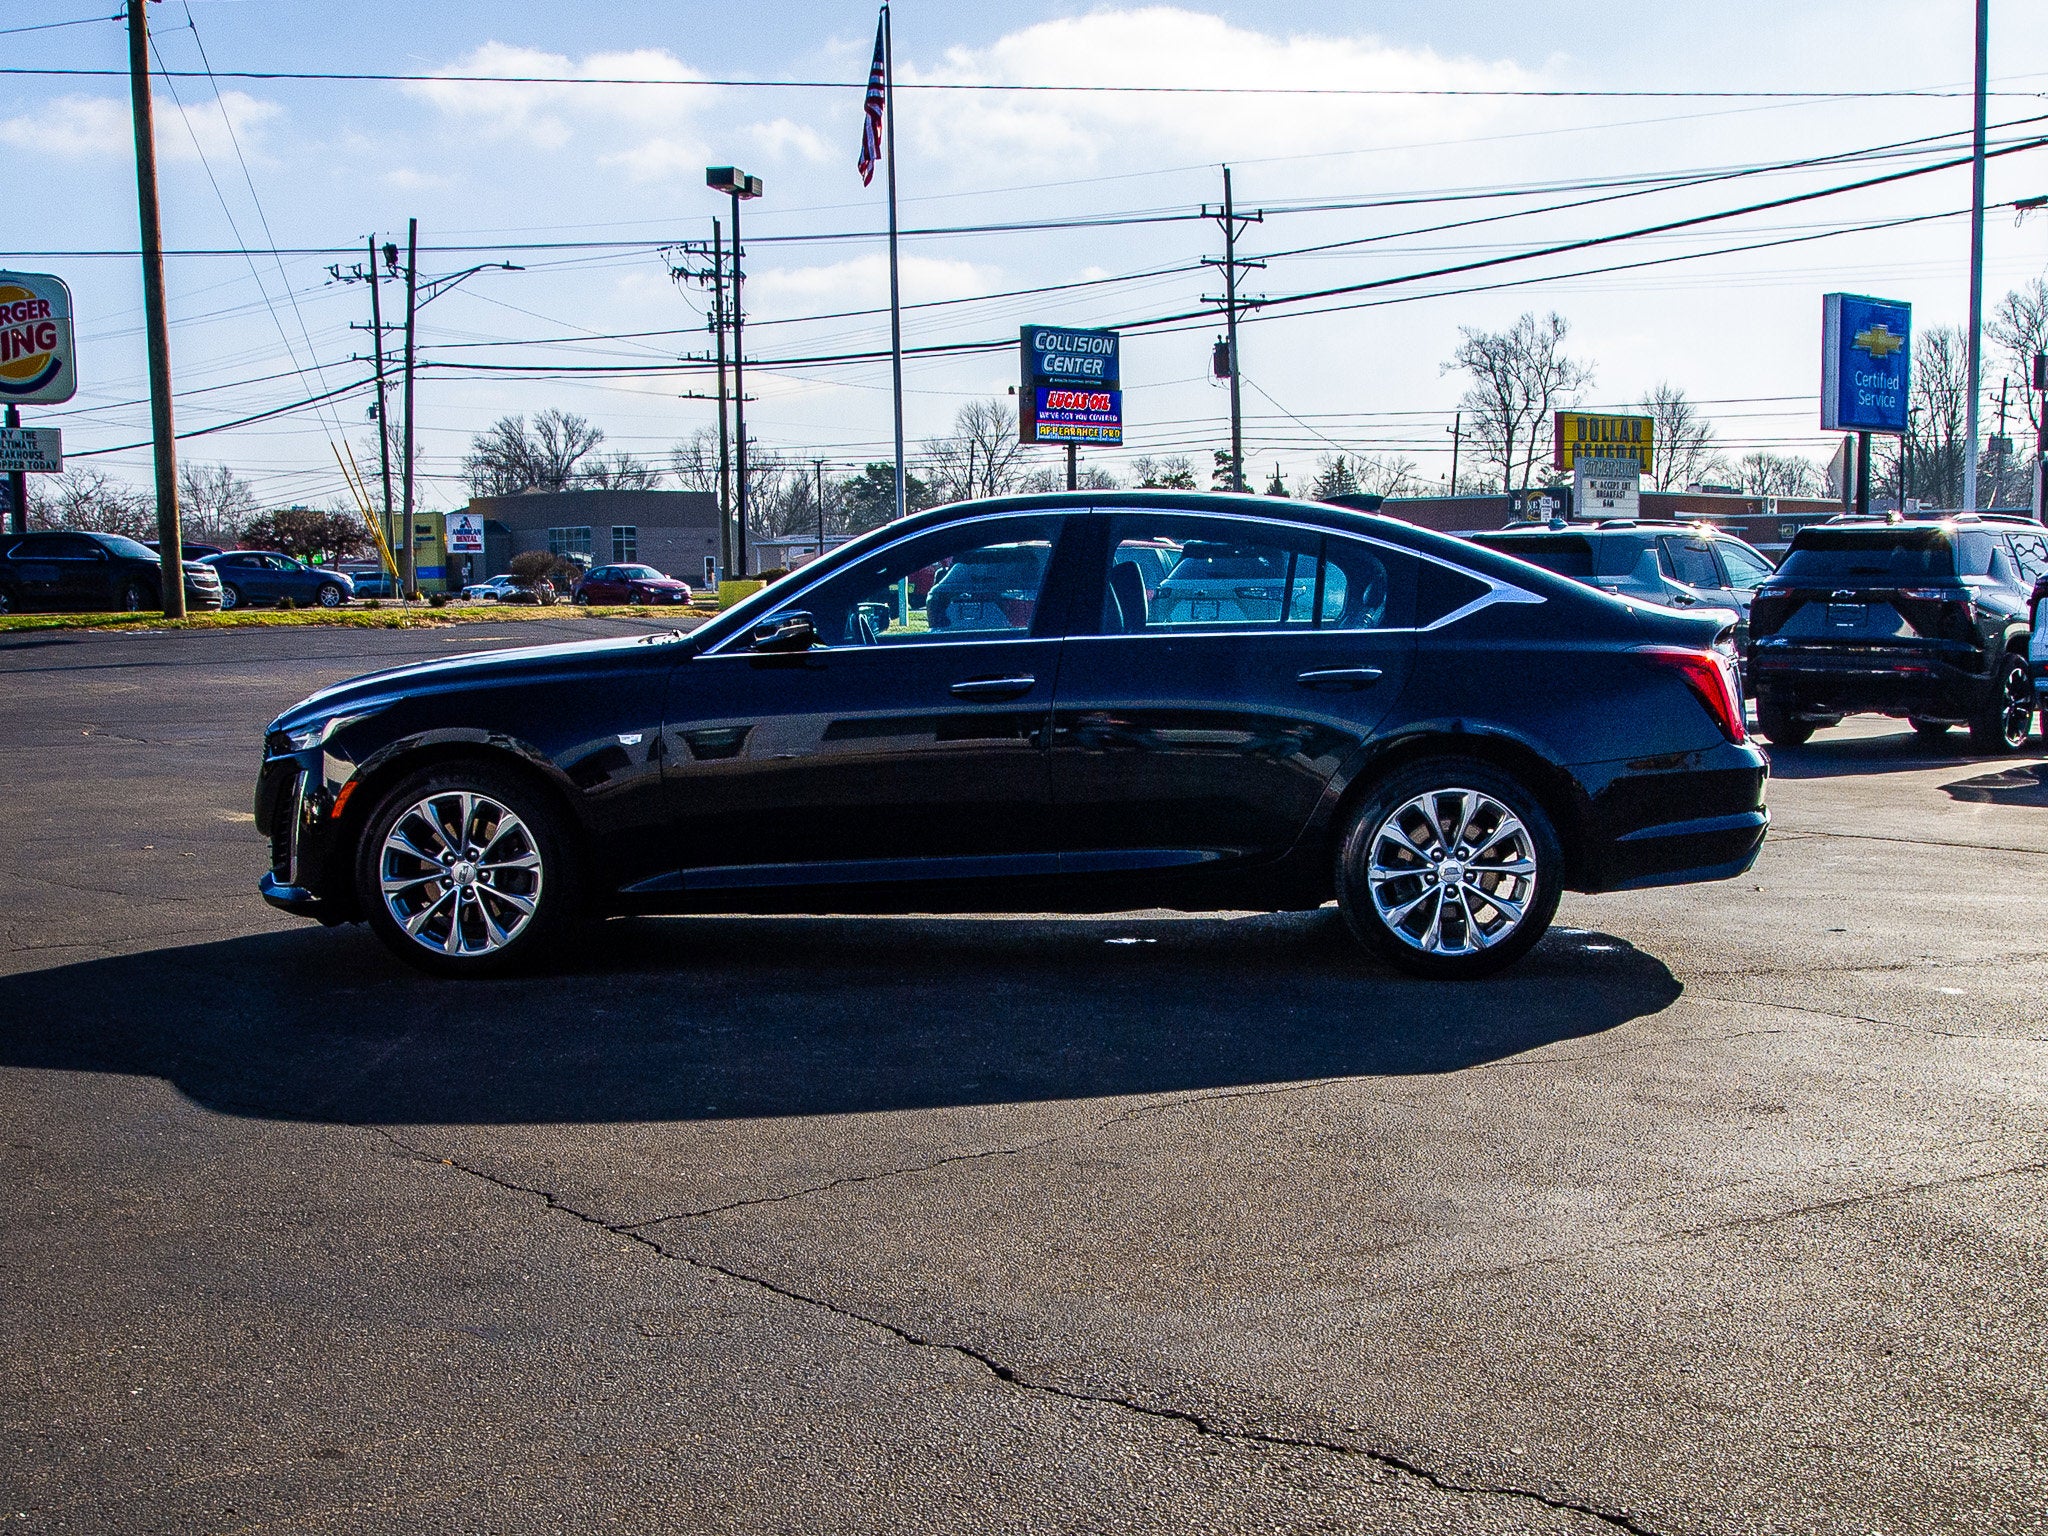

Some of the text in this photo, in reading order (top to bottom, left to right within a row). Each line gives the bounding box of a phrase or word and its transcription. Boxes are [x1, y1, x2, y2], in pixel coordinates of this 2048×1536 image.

[1035, 332, 1114, 354] COLLISION
[1043, 353, 1103, 375] CENTER
[1855, 370, 1899, 390] Certified
[1047, 391, 1111, 411] LUCAS OIL
[1858, 389, 1896, 408] Service
[21, 431, 37, 440] THE
[1040, 426, 1099, 437] APPEARANCE
[1577, 417, 1642, 443] DOLLAR
[28, 461, 58, 470] TODAY
